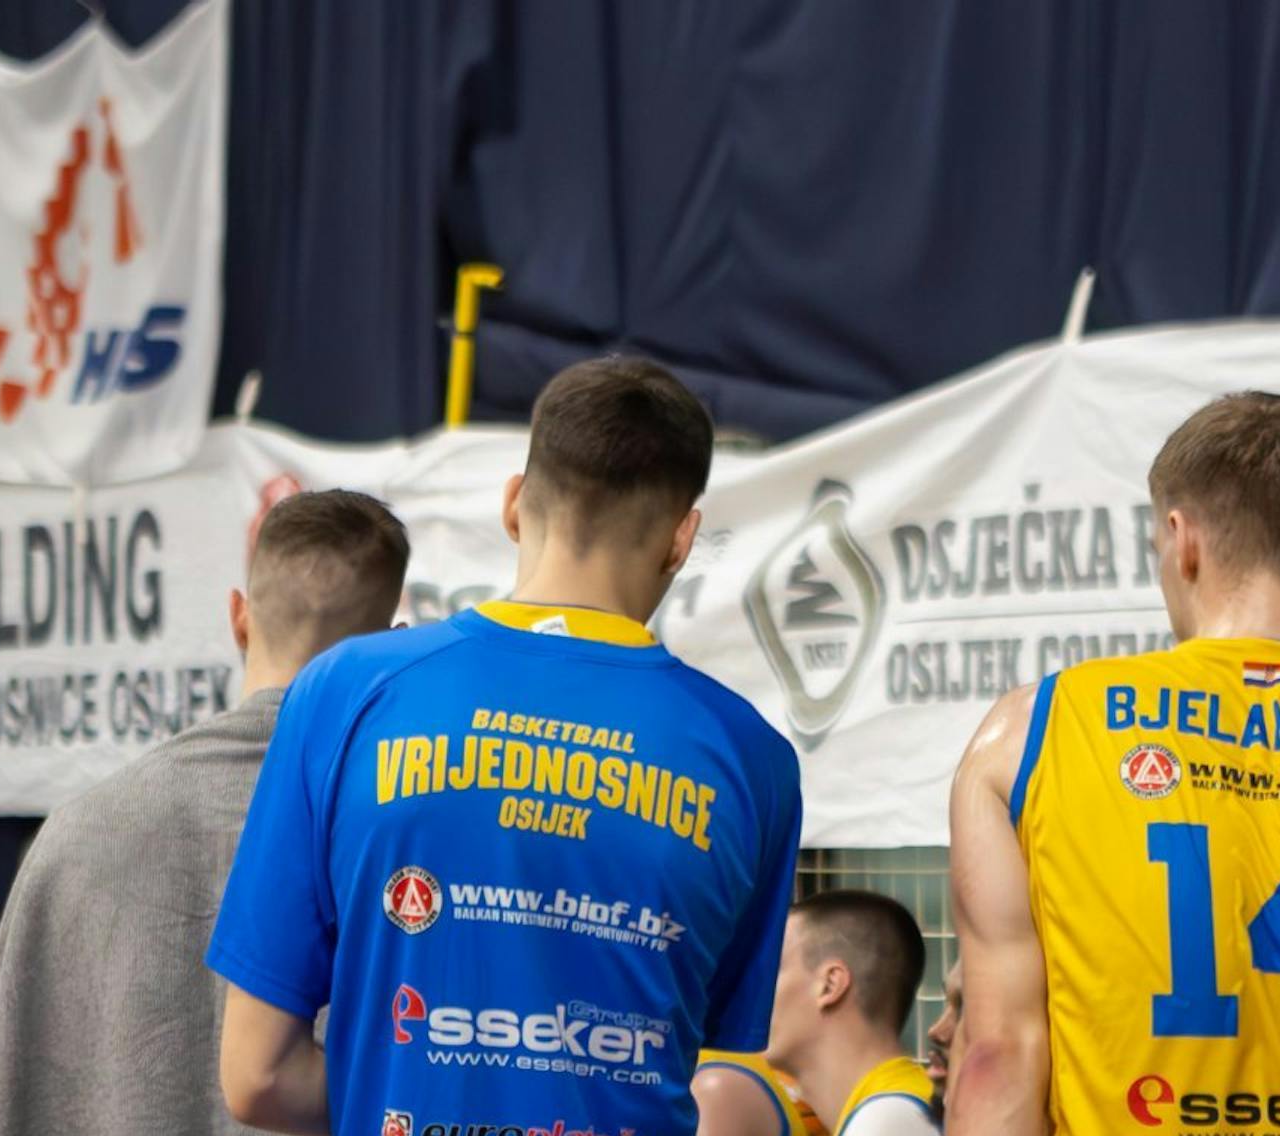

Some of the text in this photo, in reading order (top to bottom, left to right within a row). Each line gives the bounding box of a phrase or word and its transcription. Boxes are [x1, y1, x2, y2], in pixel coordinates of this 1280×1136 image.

[886, 636, 1024, 704] OSIJEK
[471, 707, 635, 754] BASKETBALL
[375, 734, 717, 853] VRIJEDNOSNICE
[498, 795, 592, 841] OSIJEK
[448, 883, 688, 943] www.biof.biz
[453, 906, 500, 922] BALKAN
[650, 936, 670, 953] FU
[391, 982, 666, 1066] esseker
